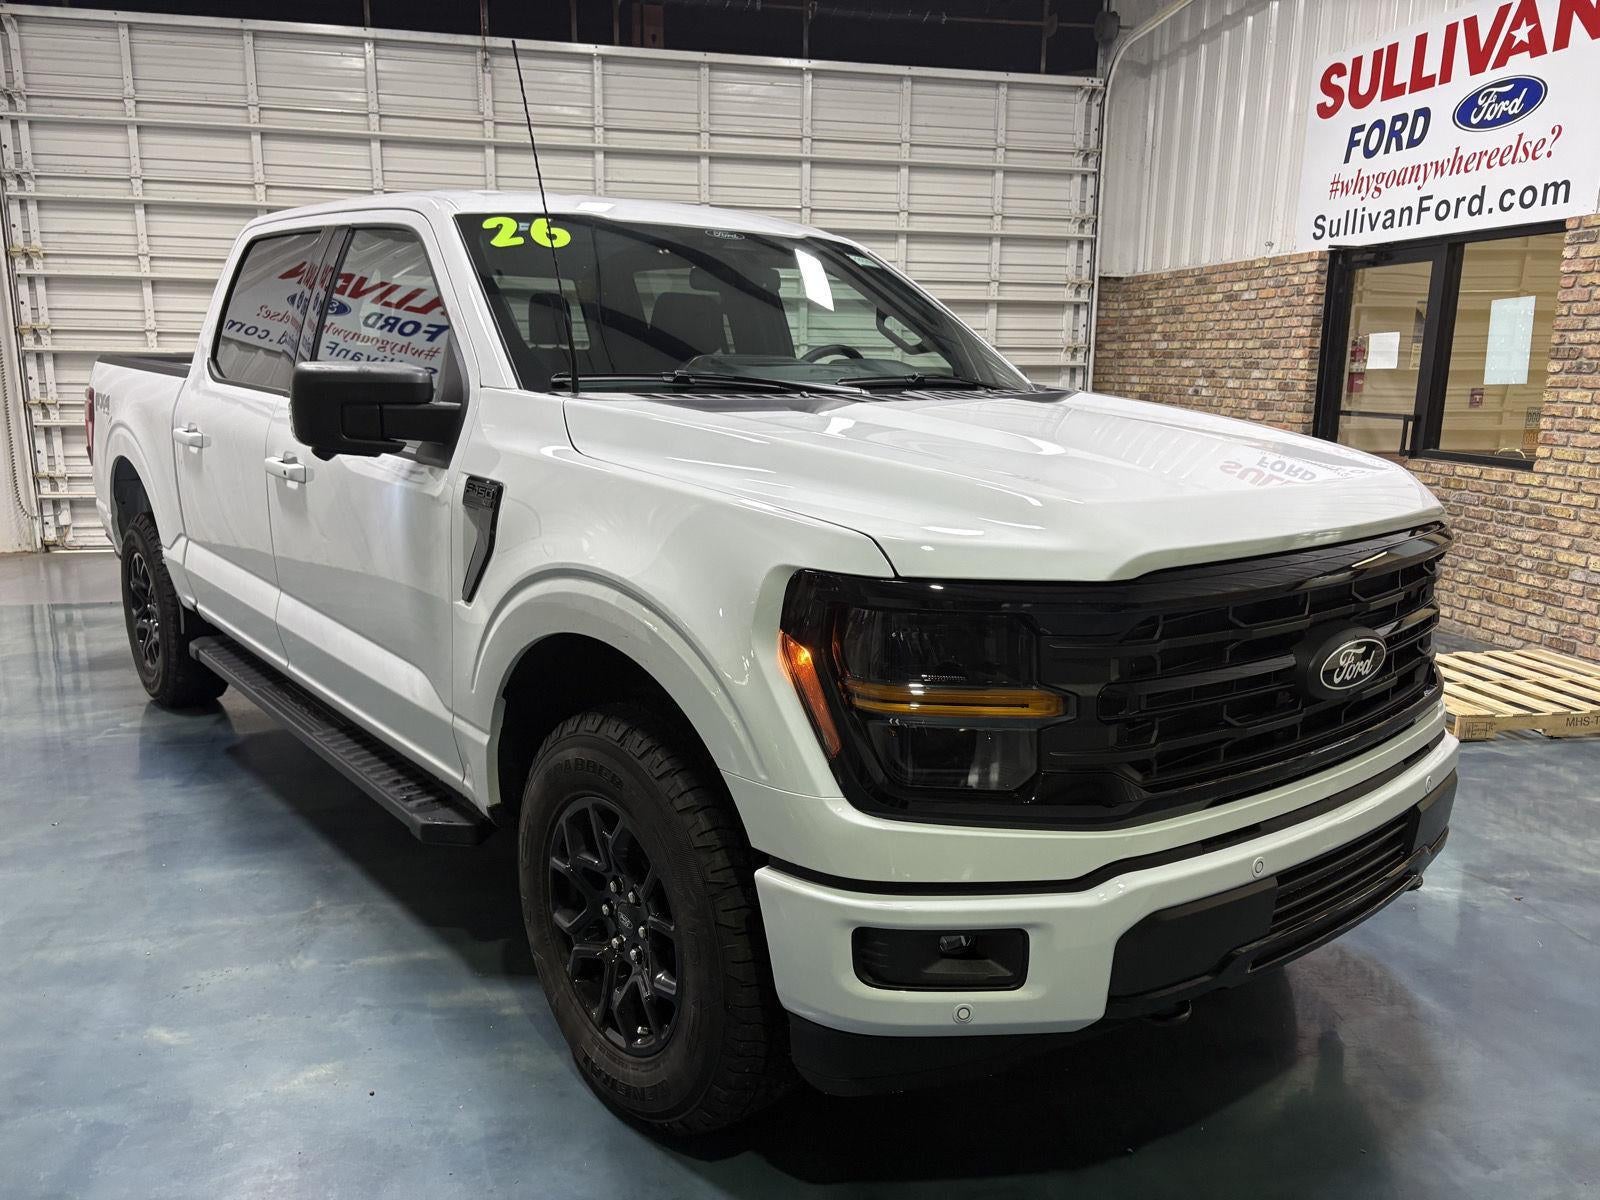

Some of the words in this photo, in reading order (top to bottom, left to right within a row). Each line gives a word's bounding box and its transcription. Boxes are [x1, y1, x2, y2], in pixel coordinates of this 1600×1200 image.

[1316, 0, 1600, 120] SULLIVAN
[1470, 82, 1525, 125] Ford
[1328, 124, 1563, 202] #whygoanywhereelse?
[1343, 106, 1432, 164] FORD
[1312, 179, 1571, 241] SullivanFord.com
[1333, 645, 1376, 684] Ford
